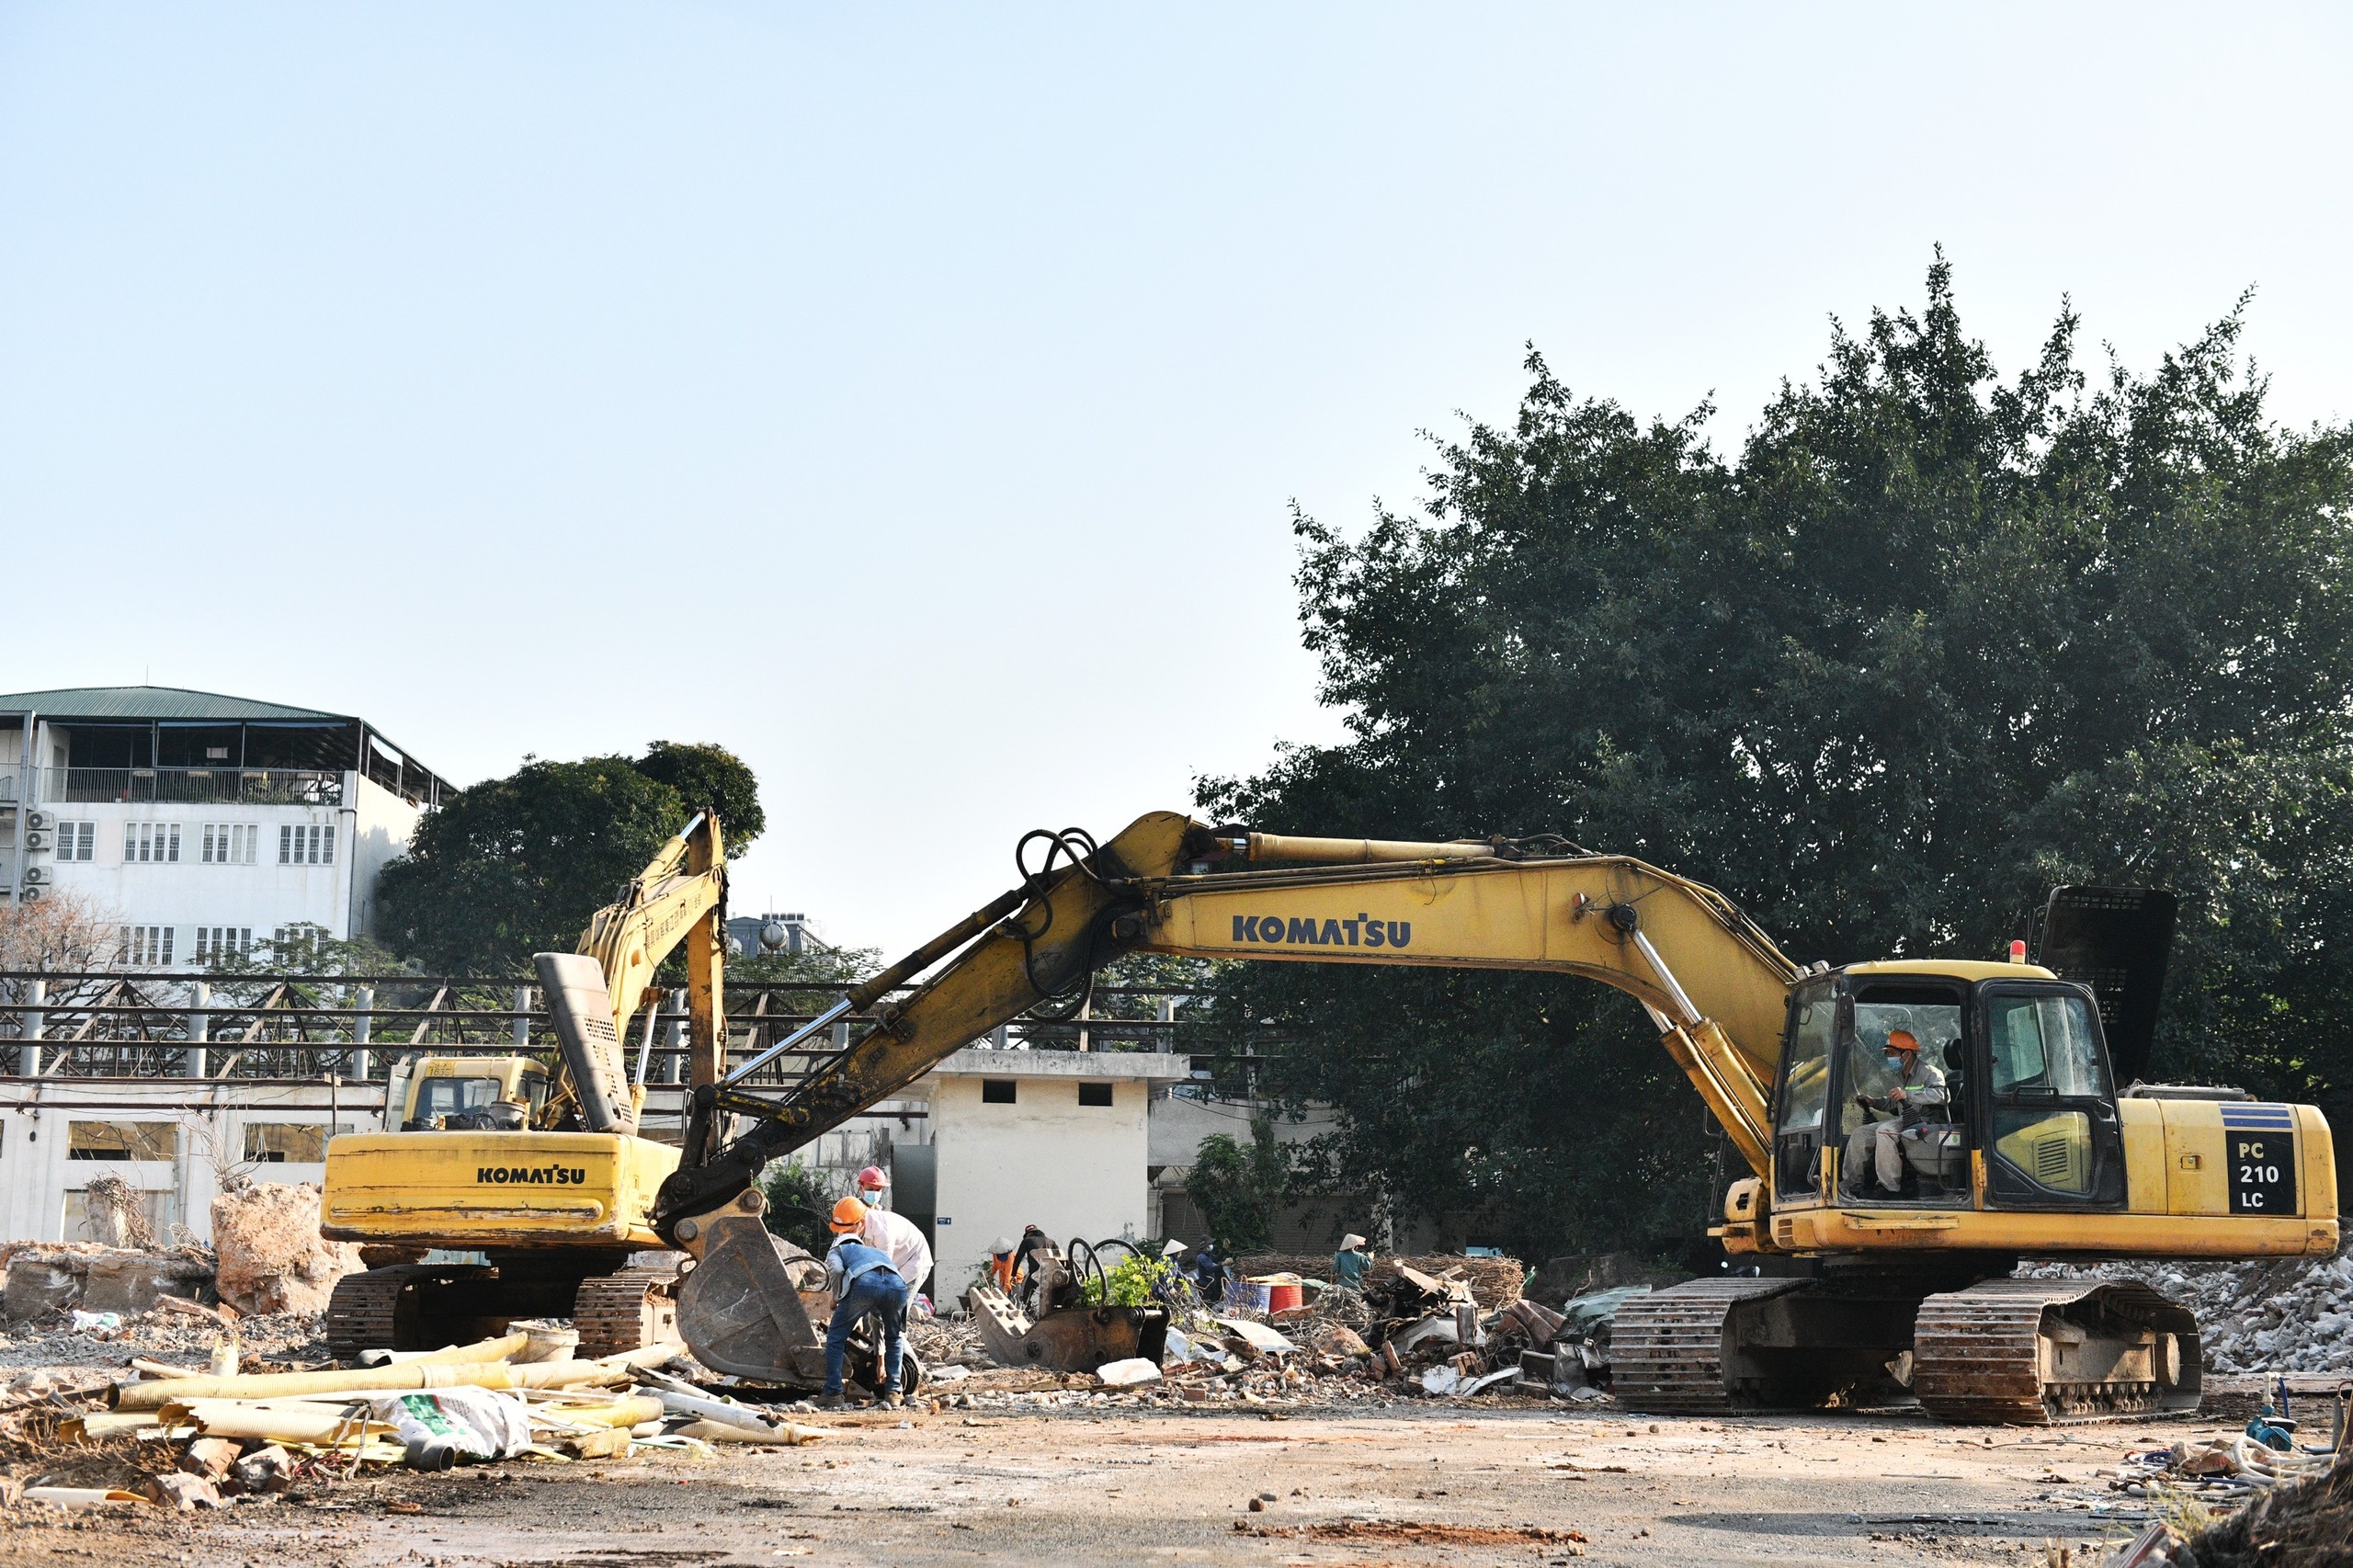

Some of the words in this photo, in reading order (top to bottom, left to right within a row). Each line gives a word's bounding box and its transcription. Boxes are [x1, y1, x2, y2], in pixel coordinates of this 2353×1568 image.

[1233, 913, 1411, 948] KOMATSU
[2238, 1142, 2264, 1159] PC
[477, 1164, 585, 1185] KOMATSU
[2240, 1165, 2279, 1183] 210
[2242, 1192, 2264, 1208] LC
